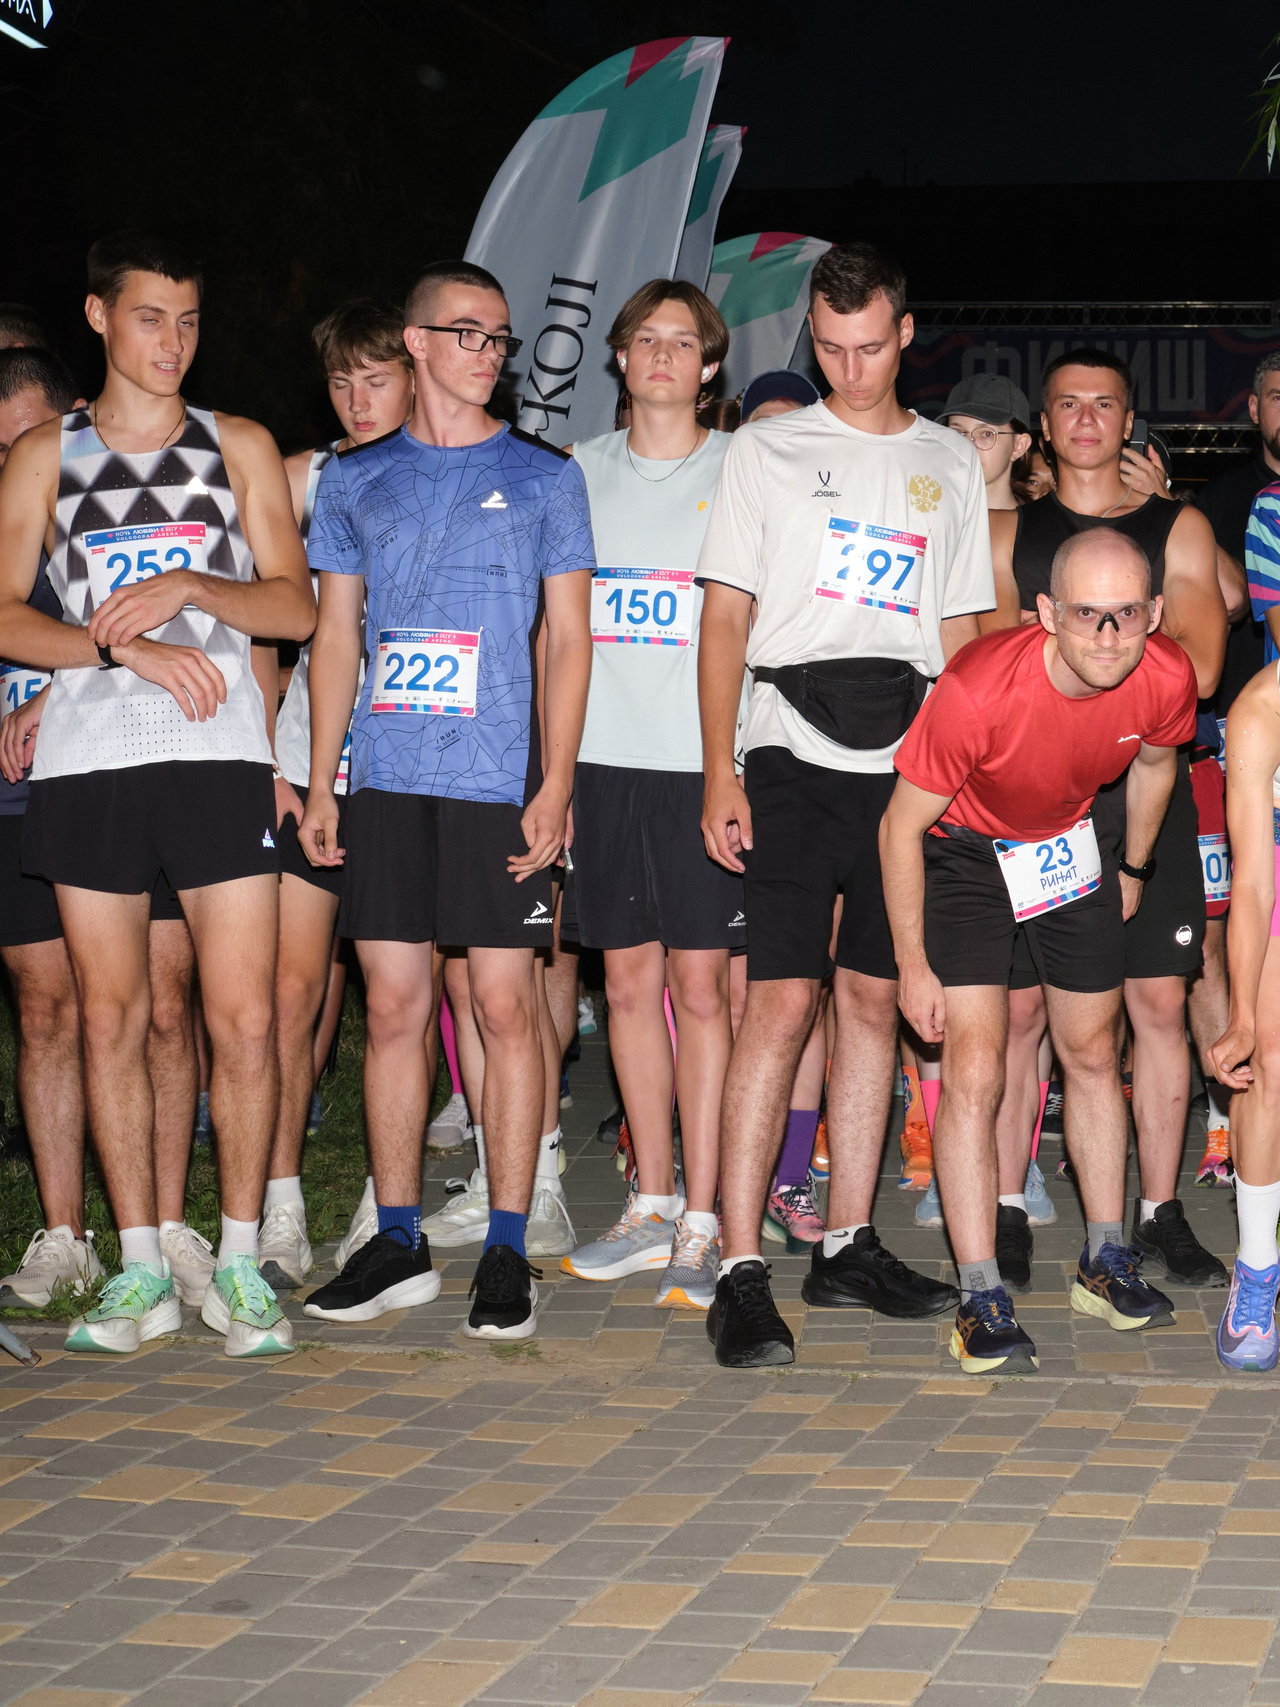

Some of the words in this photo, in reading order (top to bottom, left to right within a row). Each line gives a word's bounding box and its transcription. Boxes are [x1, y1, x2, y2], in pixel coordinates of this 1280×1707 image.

[961, 340, 1206, 412] ФИИШ
[811, 489, 841, 498] JÖGEL
[106, 546, 192, 594] 252
[605, 588, 677, 627] 150
[383, 652, 460, 693] 222
[1036, 837, 1073, 874] 23
[1205, 852, 1230, 883] 07
[1040, 865, 1078, 891] РИНАТ
[523, 917, 554, 925] DEMIX
